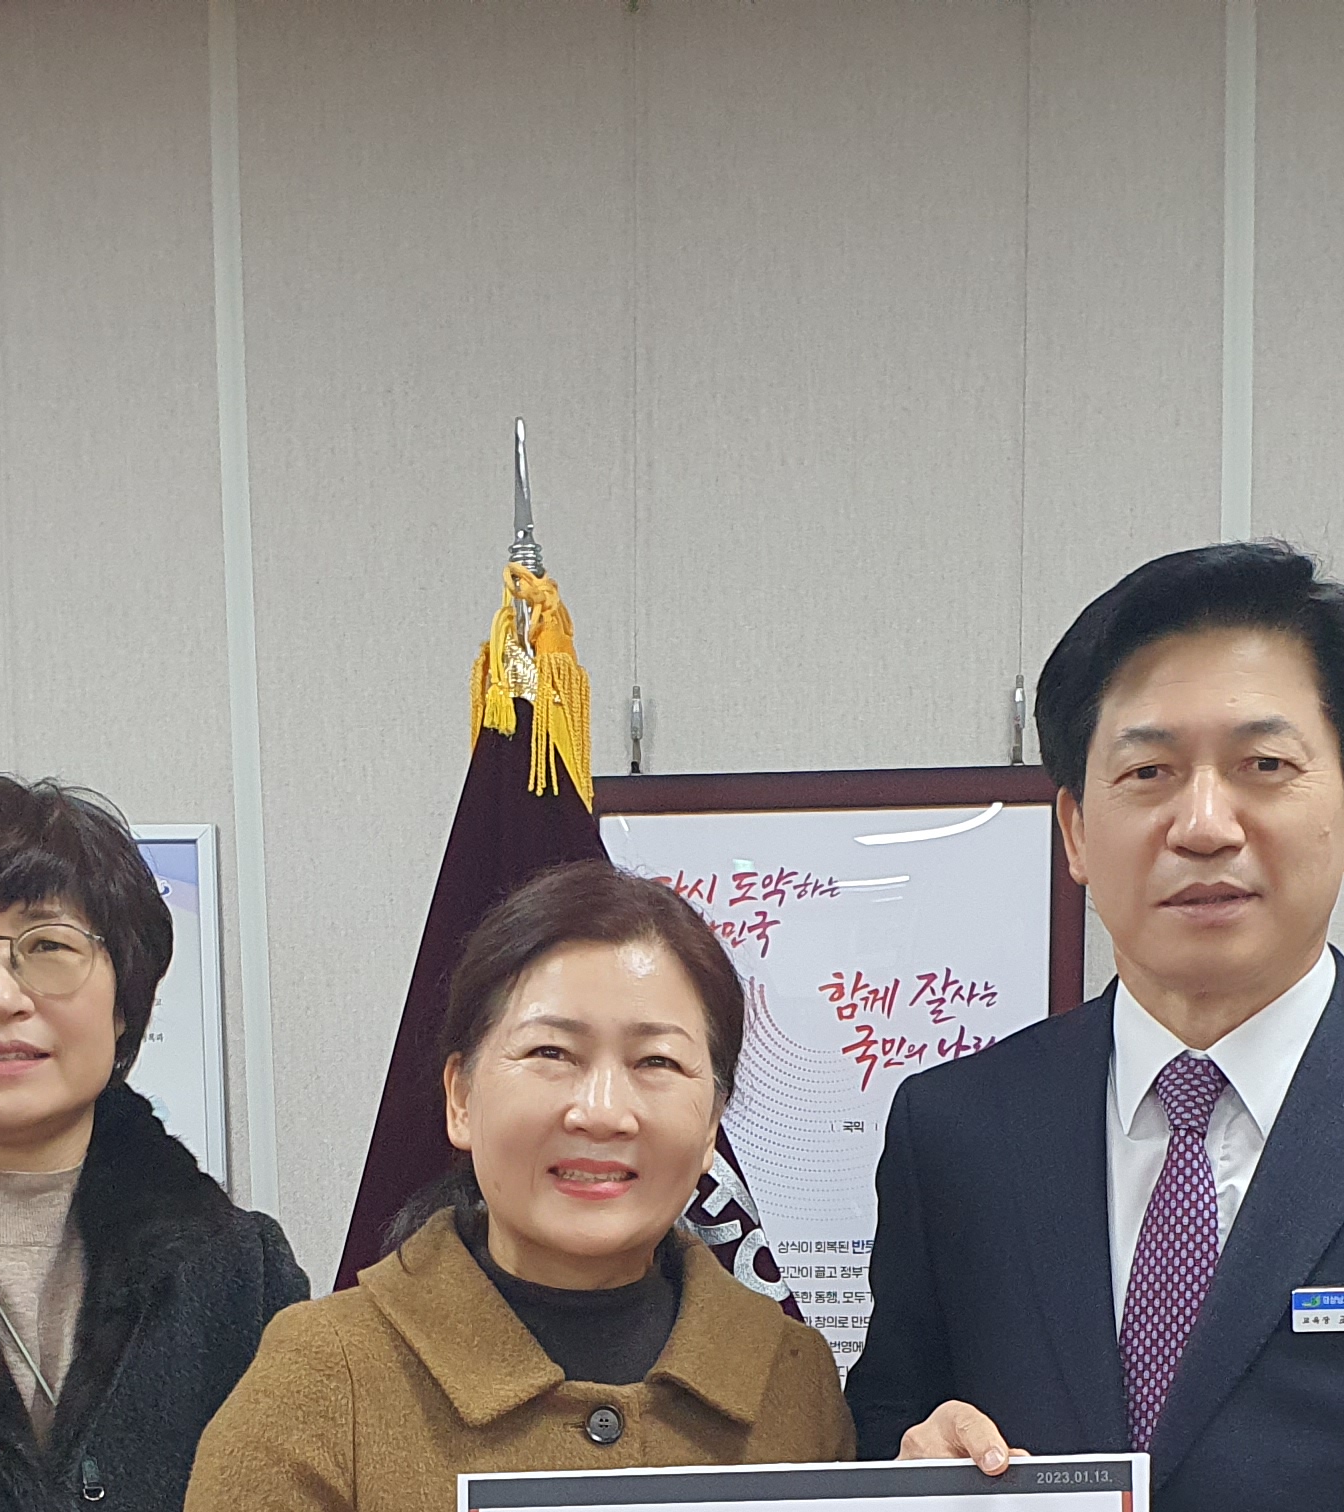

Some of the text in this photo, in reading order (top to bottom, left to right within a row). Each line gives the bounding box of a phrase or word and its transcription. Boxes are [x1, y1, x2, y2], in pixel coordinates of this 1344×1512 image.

[729, 867, 841, 907] 도약하는
[709, 910, 781, 958] 민국
[818, 967, 998, 1023] 함께 잘사는
[841, 1024, 928, 1091] 국민의
[842, 1121, 864, 1132] 국익
[778, 1240, 812, 1254] 상식이
[814, 1240, 850, 1254] 회복된
[814, 1266, 838, 1278] 끌고
[1036, 1470, 1112, 1488] 2023.01.13.
